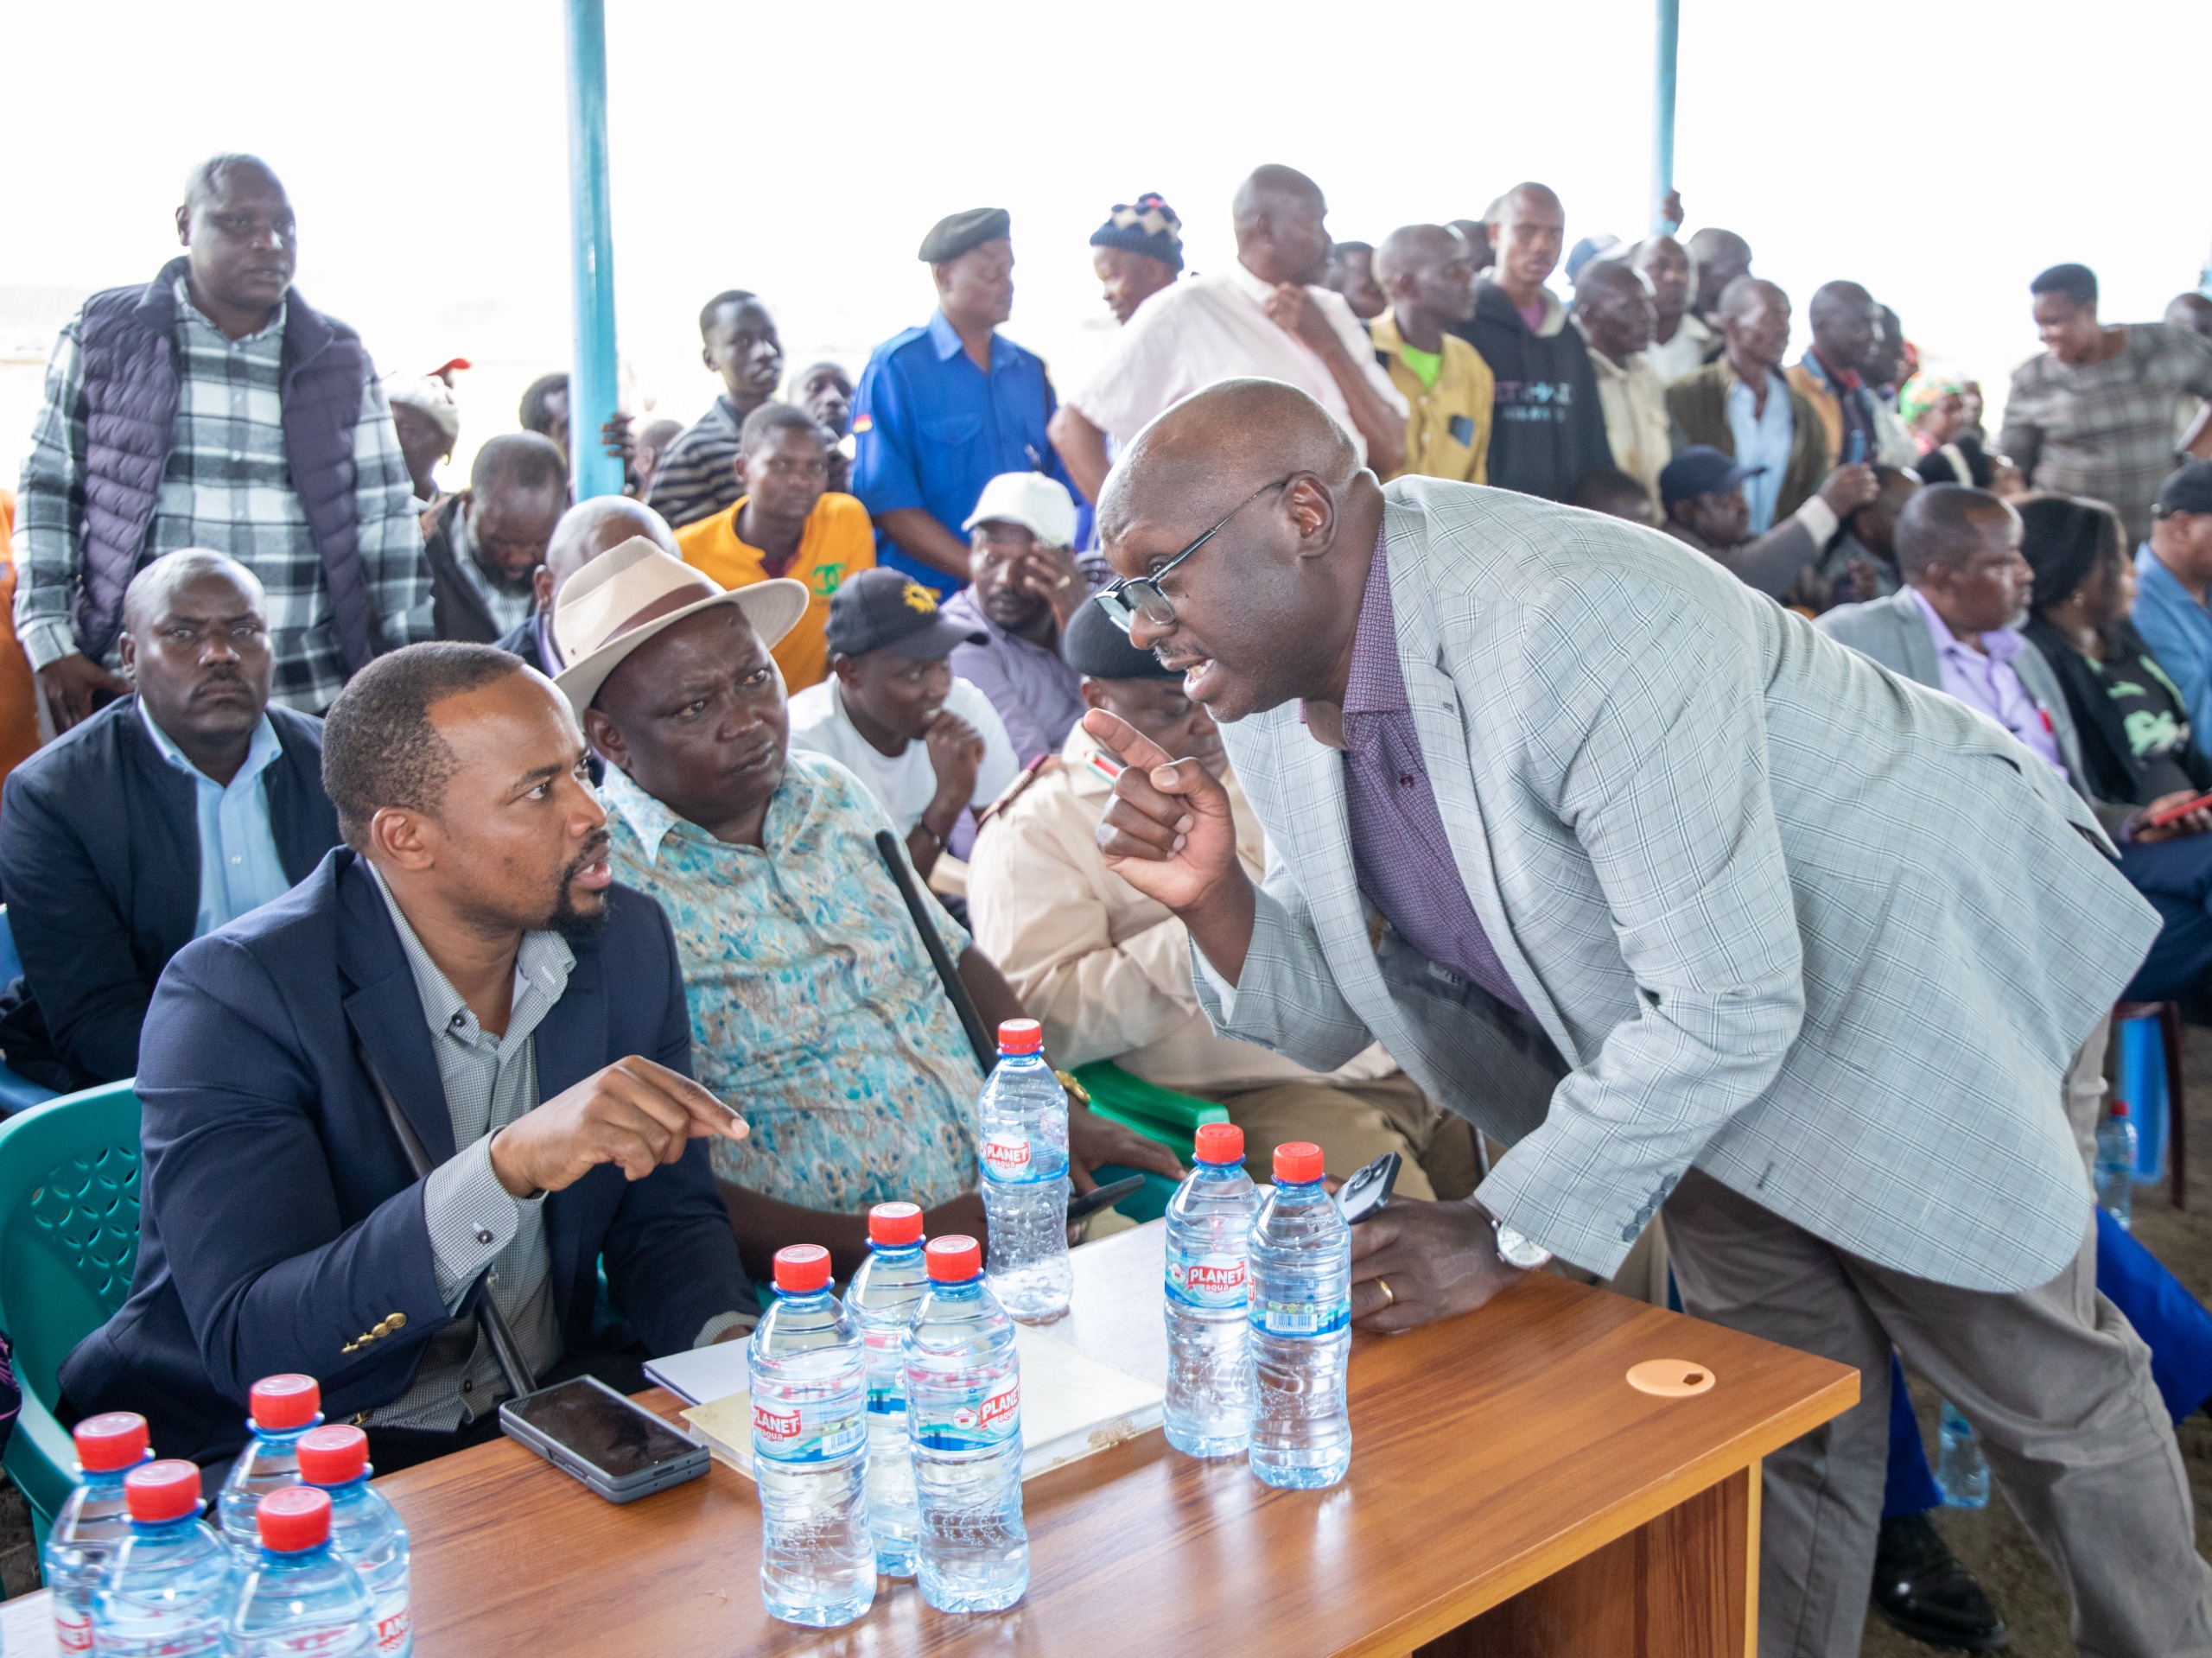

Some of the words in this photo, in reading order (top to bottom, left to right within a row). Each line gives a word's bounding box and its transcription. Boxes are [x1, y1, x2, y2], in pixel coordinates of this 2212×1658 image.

[988, 1145, 1028, 1162] PLANET
[1190, 1267, 1243, 1285] PLANET
[1205, 1284, 1229, 1293] aqua
[982, 1388, 1018, 1420] PLANE
[753, 1408, 799, 1434] PLANET
